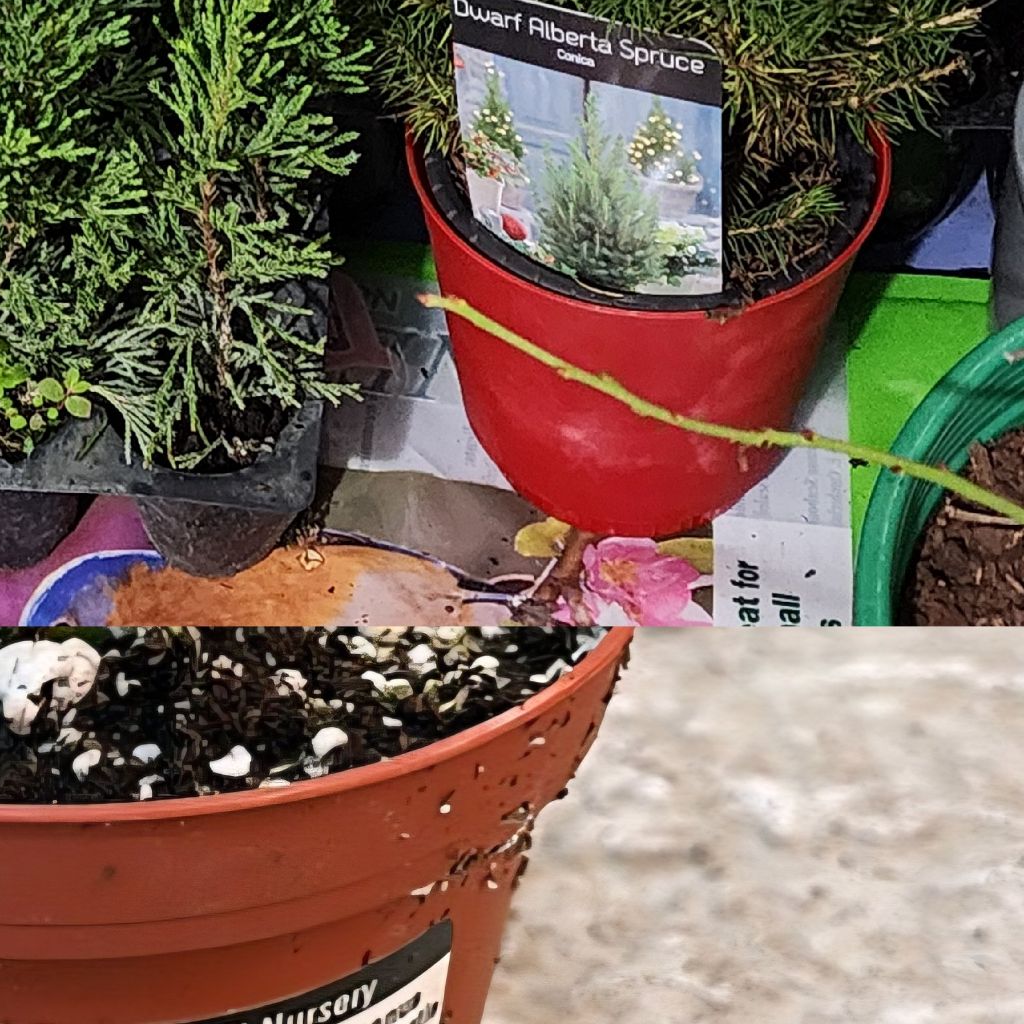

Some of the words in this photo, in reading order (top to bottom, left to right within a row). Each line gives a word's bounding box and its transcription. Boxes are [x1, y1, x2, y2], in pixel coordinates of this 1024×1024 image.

[529, 16, 612, 56] Alberta
[619, 38, 705, 75] Spruce
[556, 48, 596, 68] Conica
[730, 559, 761, 589] for
[732, 595, 761, 626] at
[771, 592, 801, 626] all
